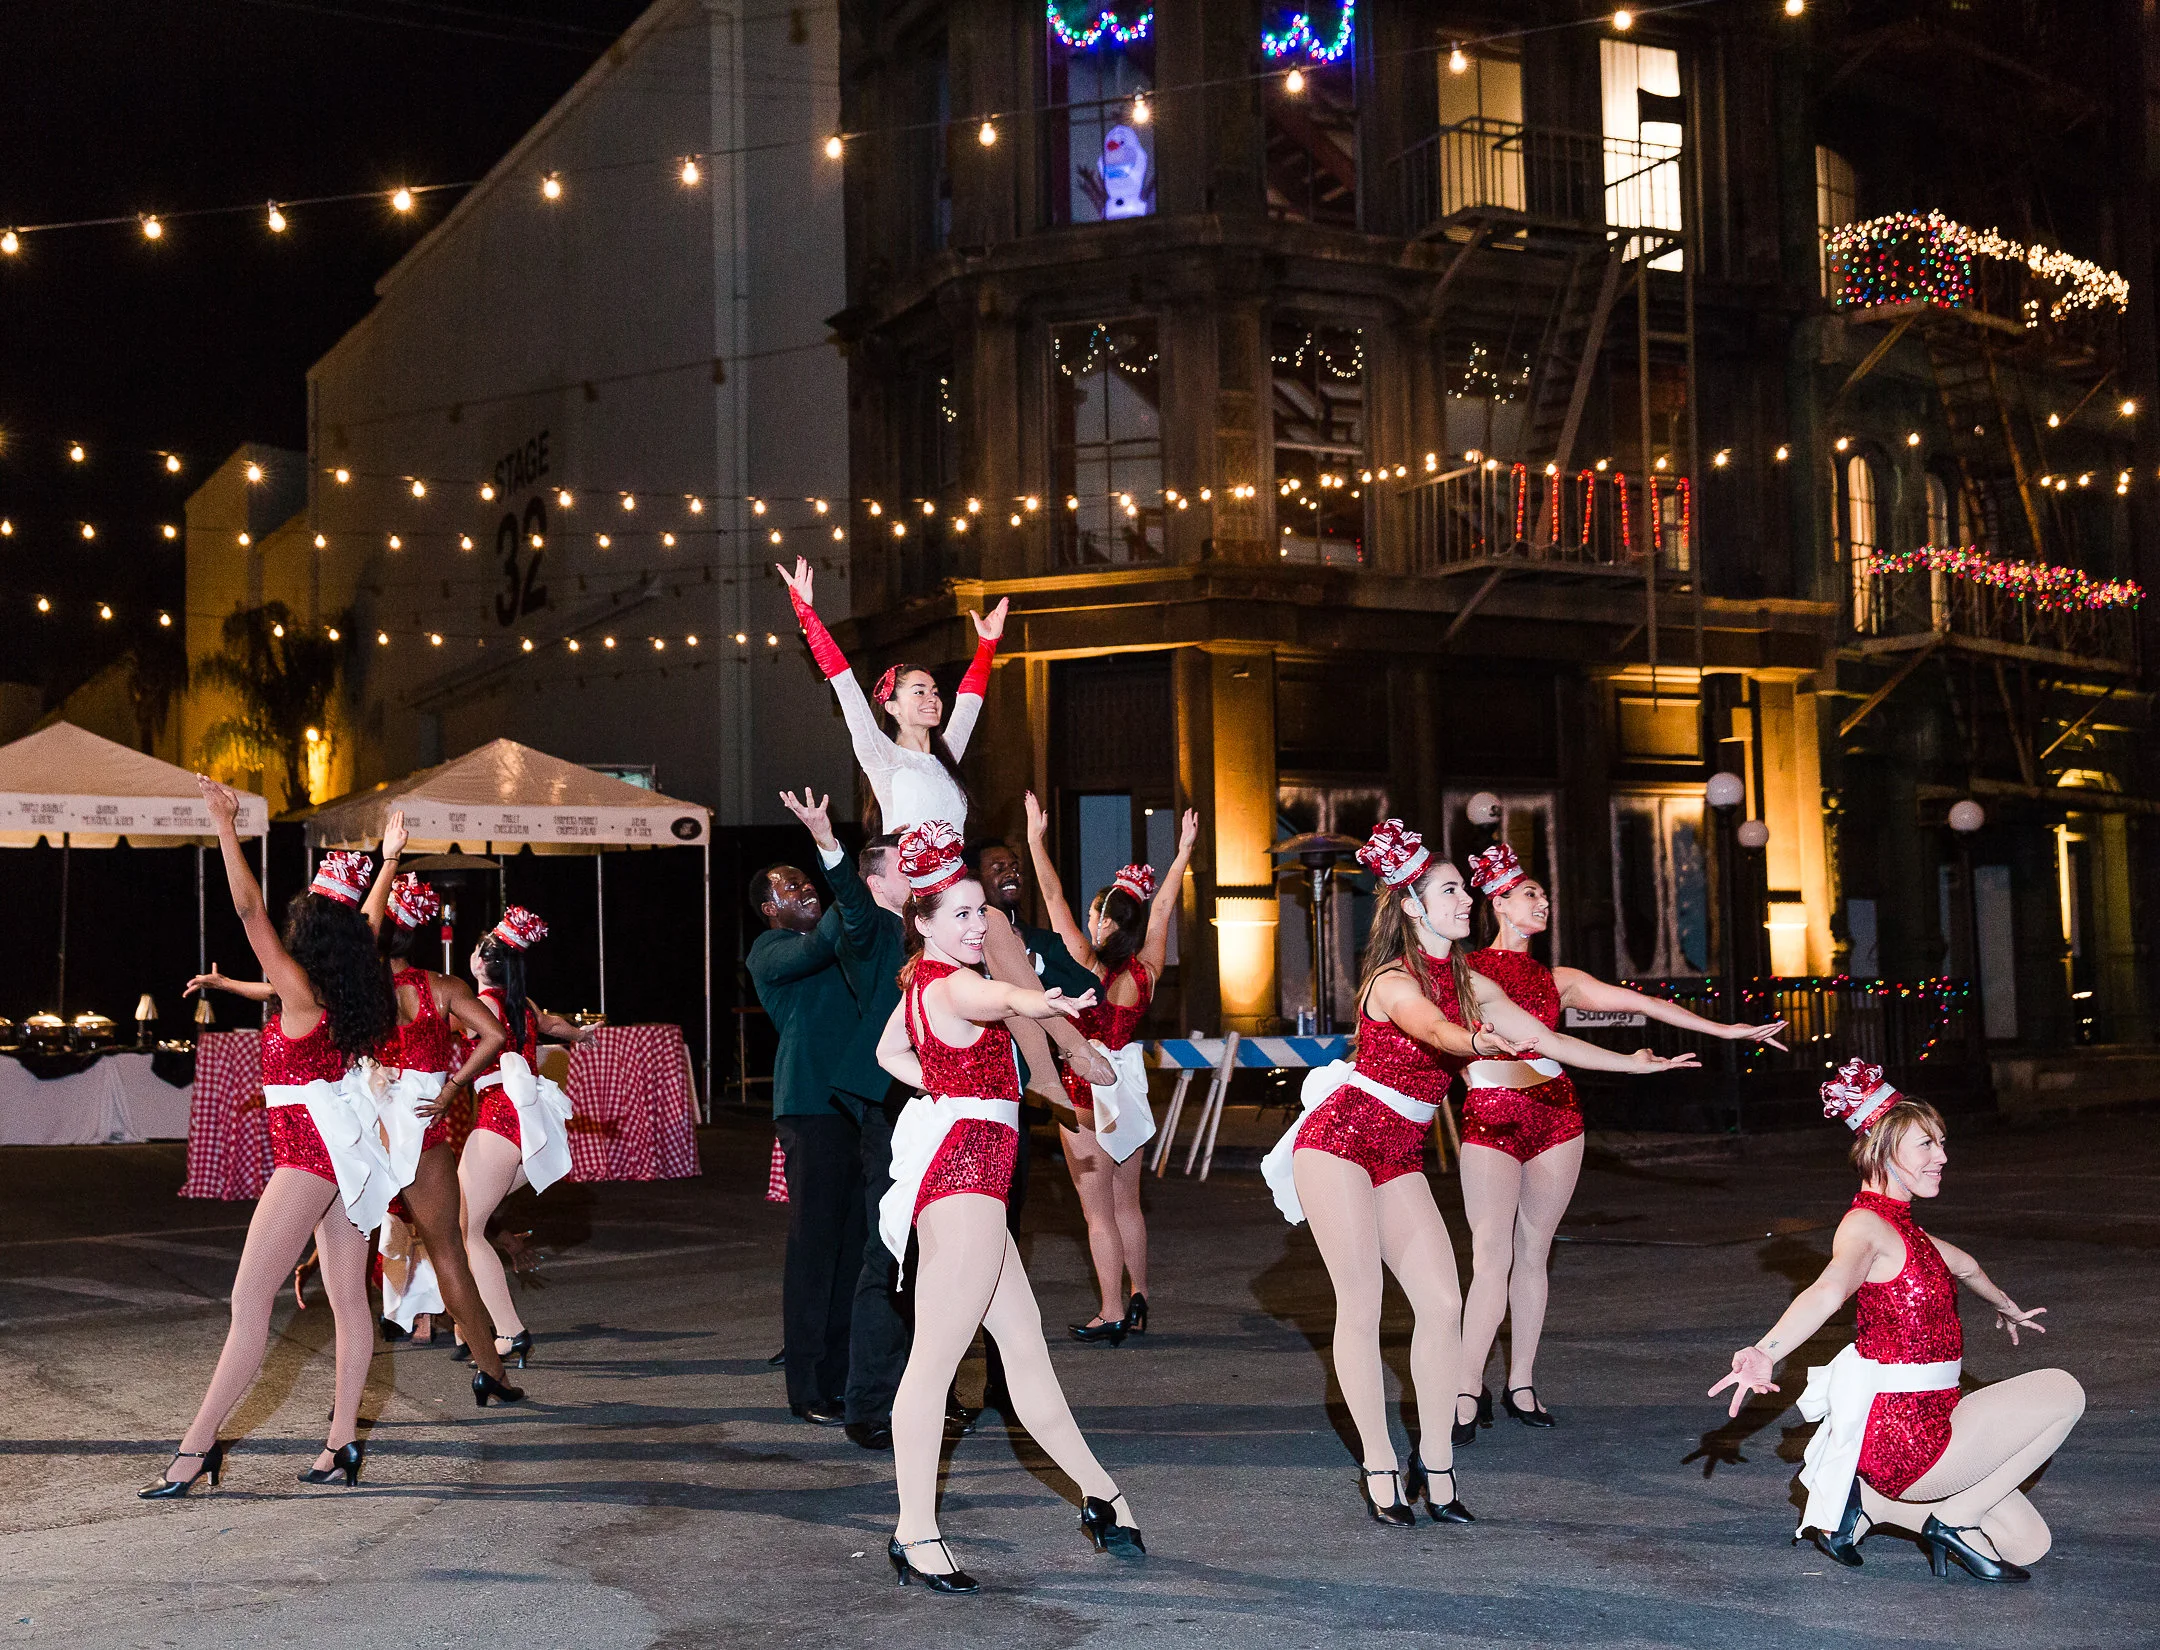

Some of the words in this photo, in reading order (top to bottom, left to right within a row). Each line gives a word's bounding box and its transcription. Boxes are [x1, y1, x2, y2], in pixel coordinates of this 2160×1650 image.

[494, 430, 549, 502] STAGE
[496, 496, 548, 627] 32
[1576, 1009, 1635, 1023] Subway
